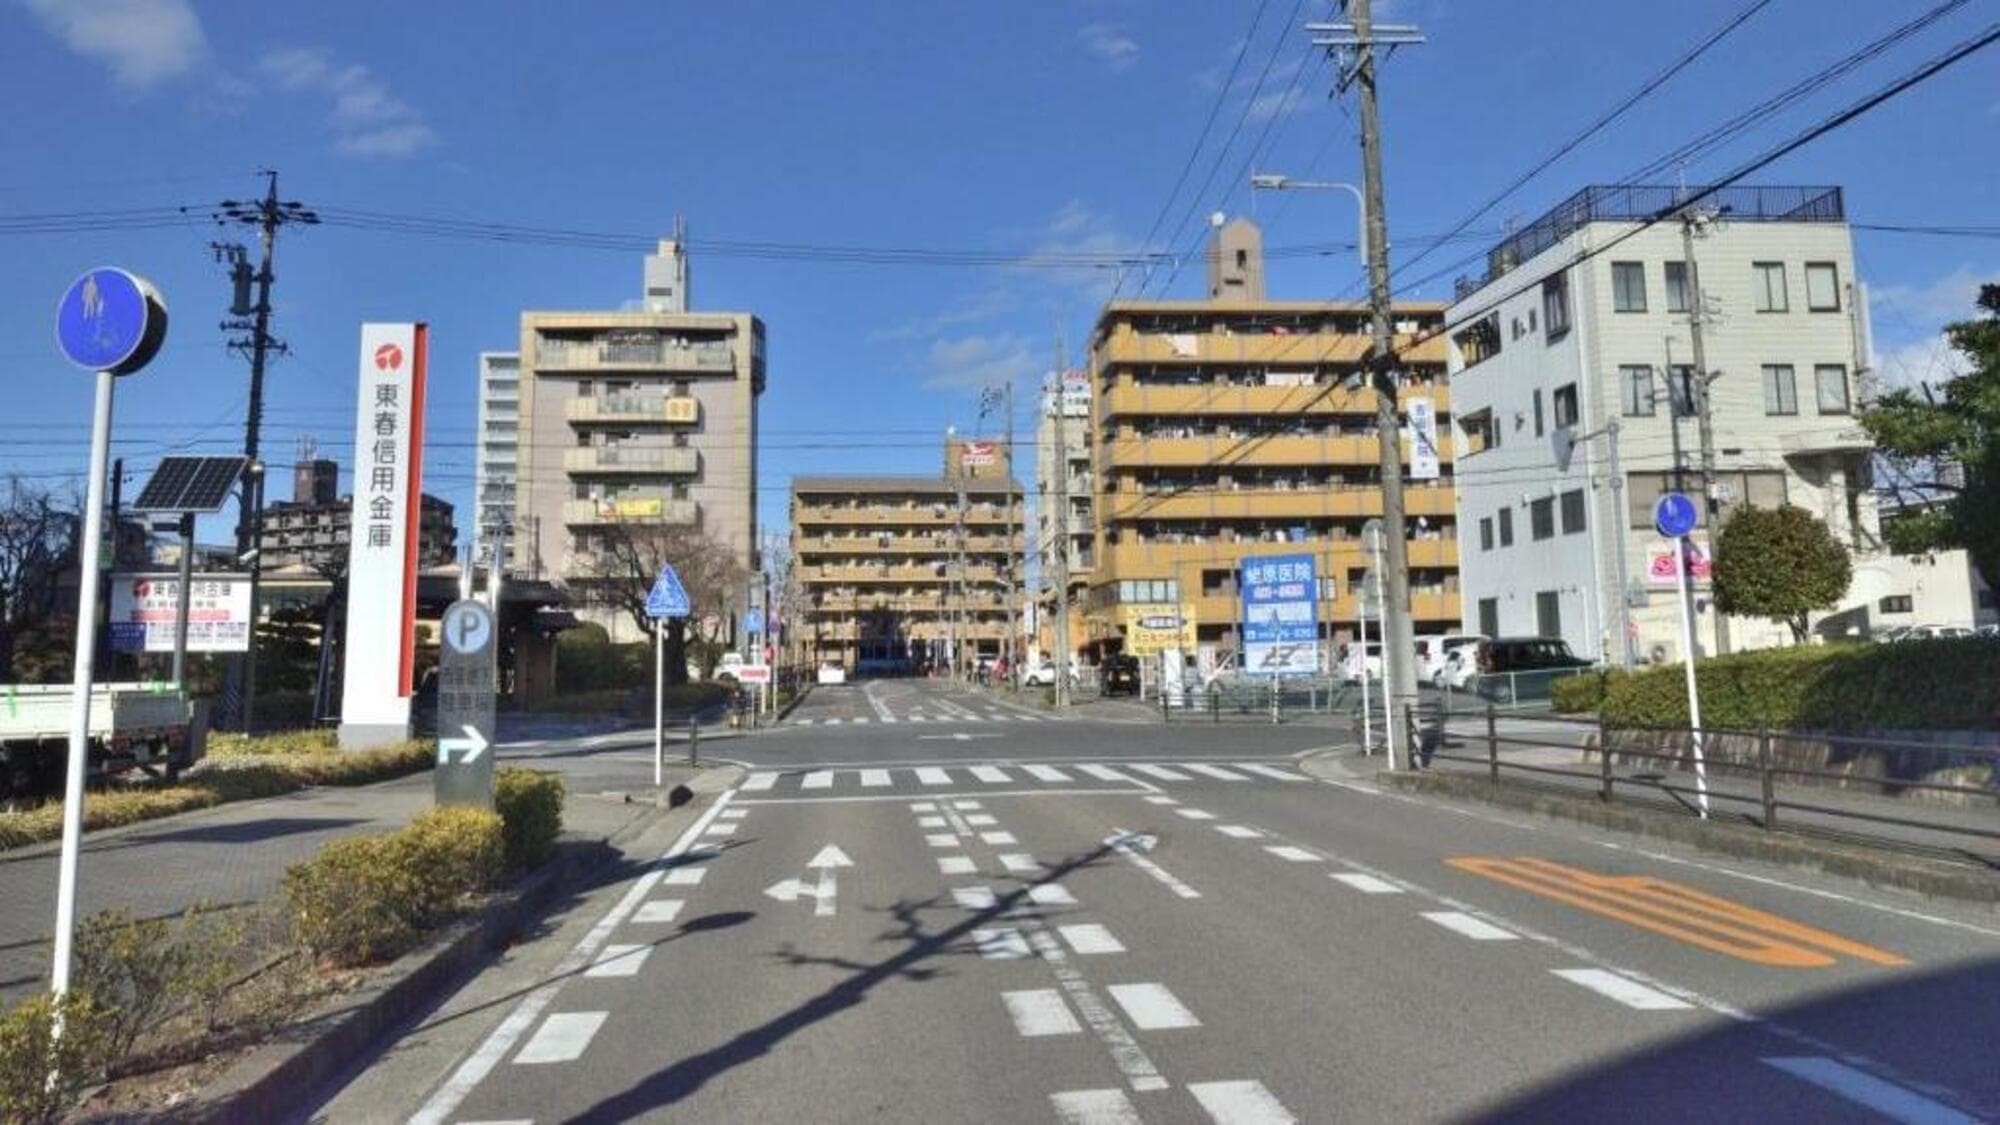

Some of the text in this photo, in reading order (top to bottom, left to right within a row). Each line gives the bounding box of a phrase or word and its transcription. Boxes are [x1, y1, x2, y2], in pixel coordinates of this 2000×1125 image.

[366, 383, 399, 549] 東春信用金庫
[153, 582, 232, 598] 東春用金庫
[459, 610, 481, 648] P
